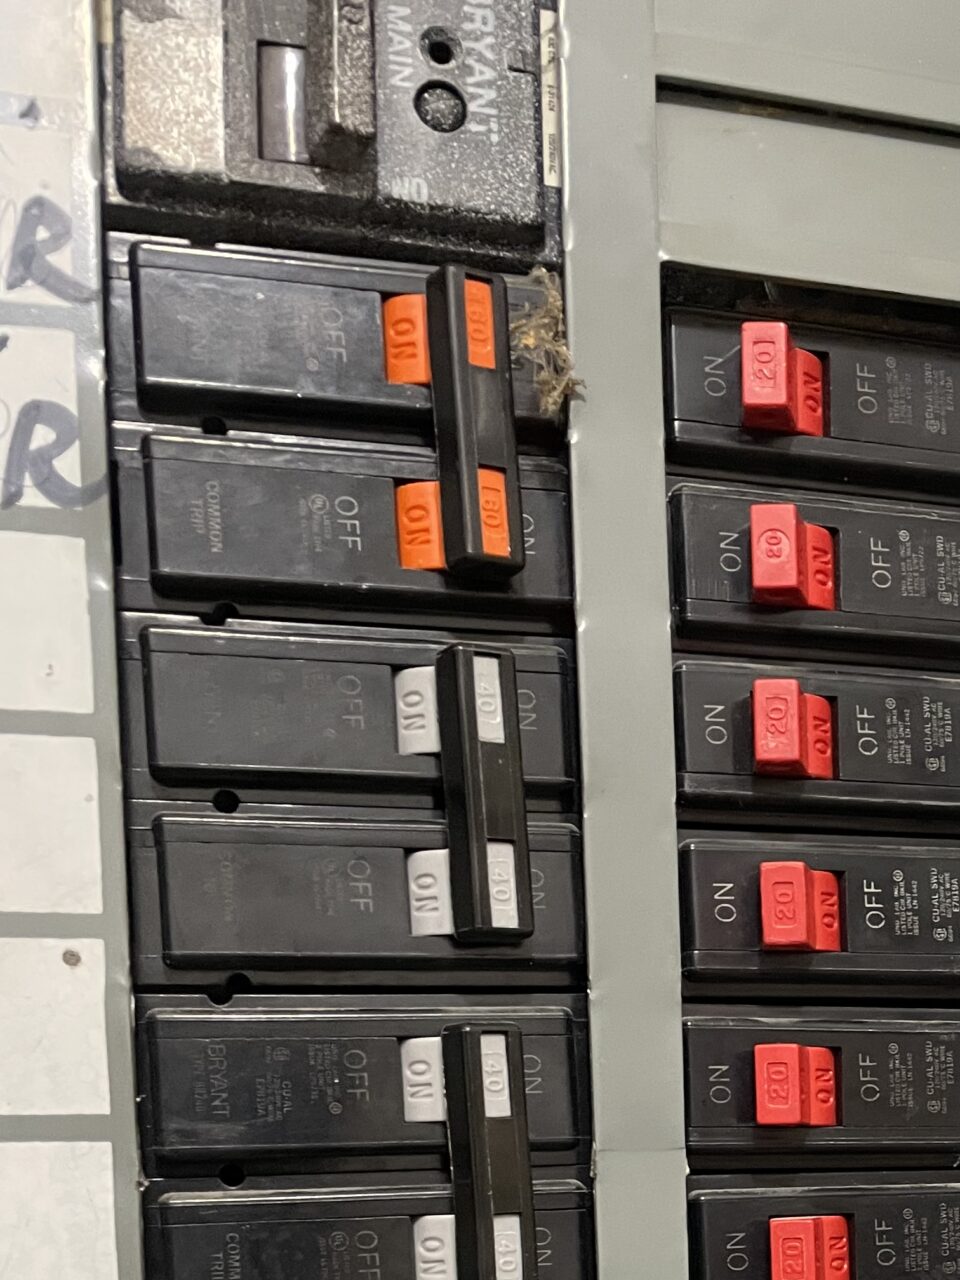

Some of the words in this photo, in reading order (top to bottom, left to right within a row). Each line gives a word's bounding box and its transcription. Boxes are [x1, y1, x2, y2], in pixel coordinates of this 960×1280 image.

[386, 5, 415, 88] MAIN
[462, 0, 499, 144] RYANT
[704, 355, 727, 397] ON
[753, 353, 777, 389] 20
[856, 362, 878, 415] OFF
[2, 400, 109, 509] R
[334, 495, 362, 552] OFF
[719, 532, 742, 572] ON
[870, 537, 892, 589] OFF
[336, 674, 365, 731] OFF
[400, 689, 427, 732] ON
[704, 704, 728, 745] ON
[767, 704, 787, 736] 20
[855, 705, 878, 756] OFF
[346, 859, 374, 913] OFF
[491, 869, 510, 901] 40
[712, 883, 737, 923] ON
[775, 888, 793, 921] 20
[863, 880, 886, 929] OFF
[208, 1043, 231, 1119] BRYANT
[343, 1049, 370, 1103] OFF
[407, 1060, 434, 1100] ON
[708, 1065, 732, 1104] ON
[859, 1053, 880, 1102] OFF
[726, 1232, 749, 1271] ON
[783, 1241, 801, 1274] 20
[874, 1219, 897, 1266] OFF
